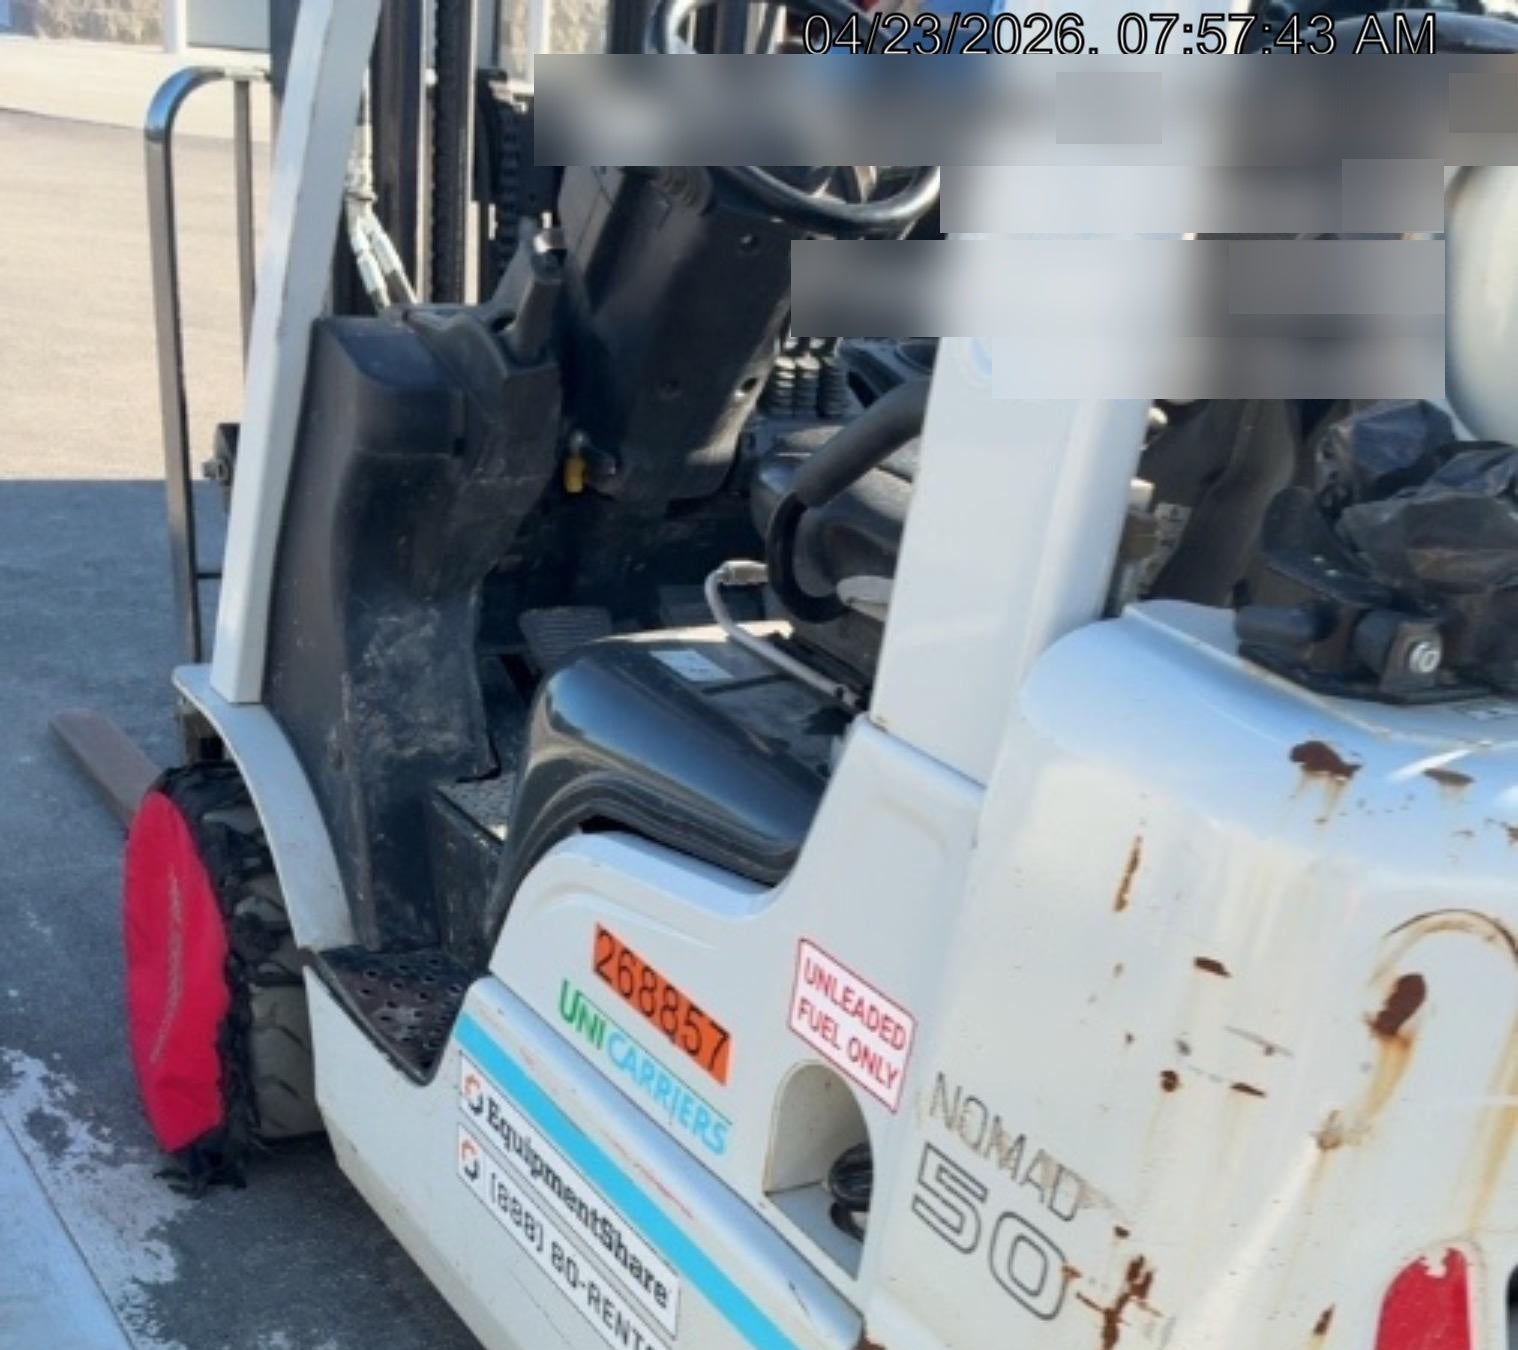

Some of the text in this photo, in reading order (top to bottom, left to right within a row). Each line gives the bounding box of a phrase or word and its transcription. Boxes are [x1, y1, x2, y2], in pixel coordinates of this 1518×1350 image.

[594, 929, 730, 1075] 268857
[798, 997, 899, 1089] FUEL ONLY
[803, 957, 907, 1052] UNLEADED
[487, 1097, 670, 1310] EquipmentShare
[489, 1172, 544, 1252] (888)
[929, 1071, 1085, 1222] NOMAD
[911, 1141, 1068, 1321] 50
